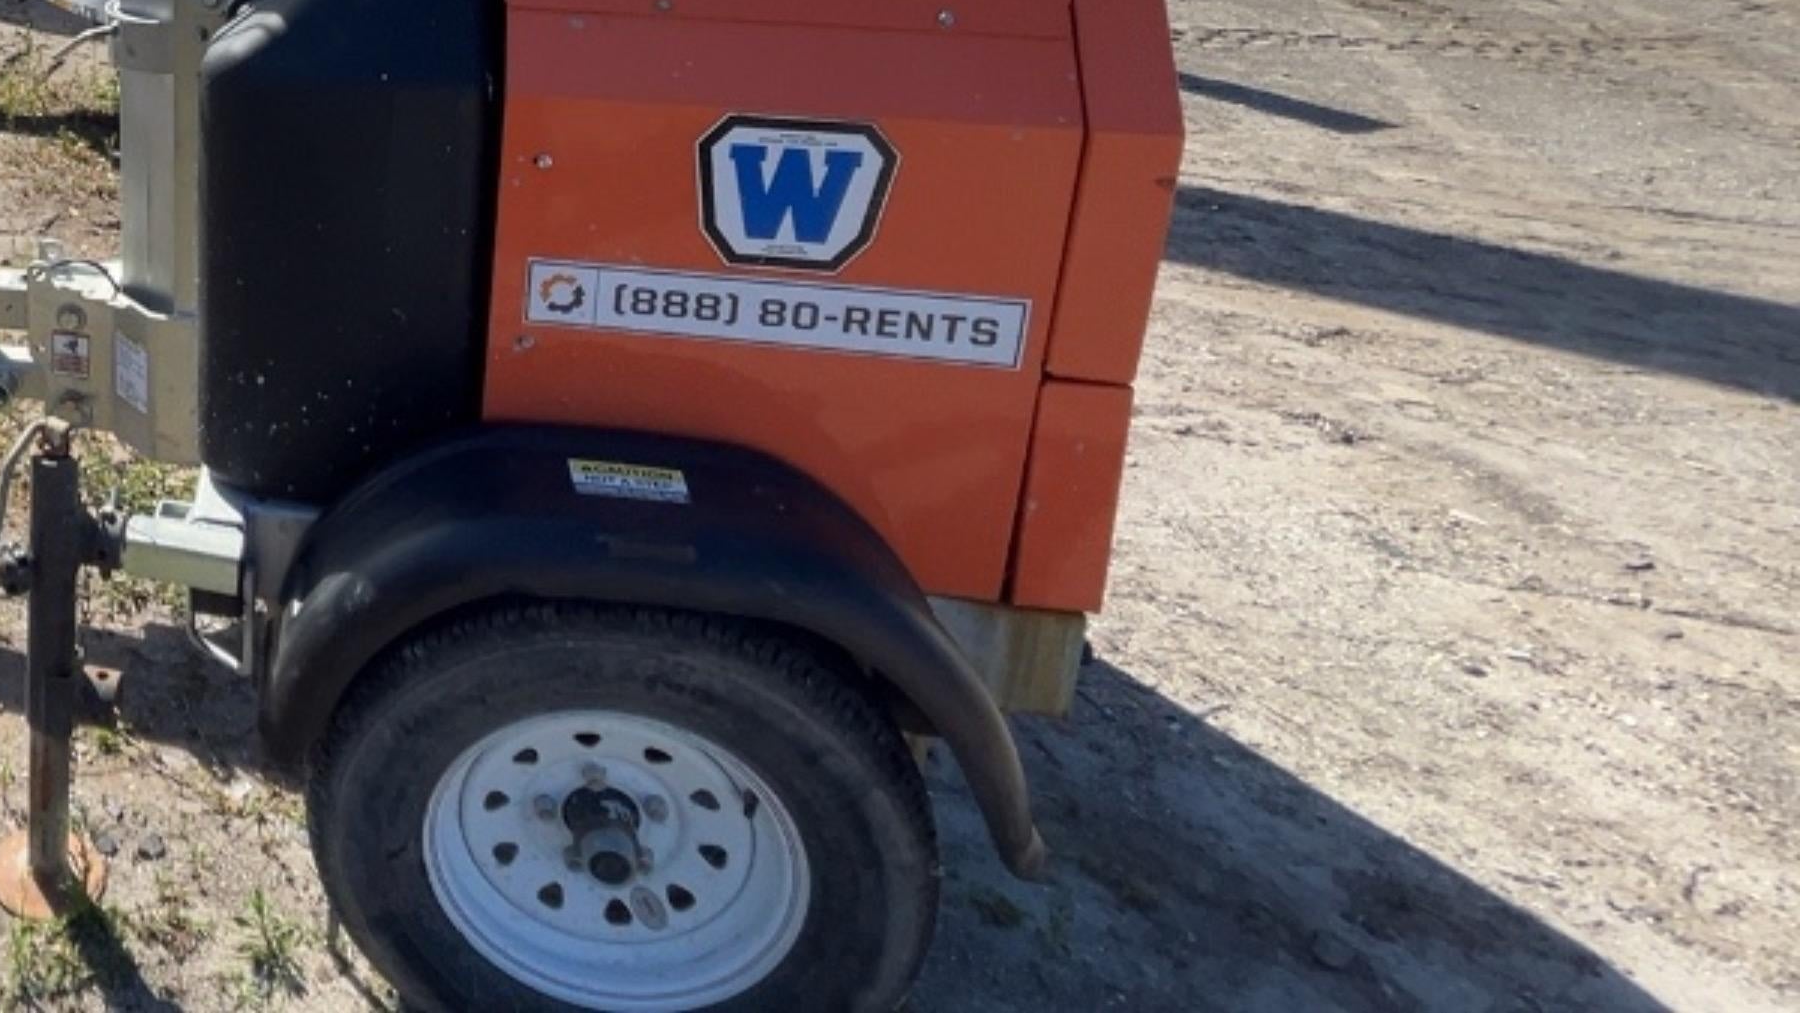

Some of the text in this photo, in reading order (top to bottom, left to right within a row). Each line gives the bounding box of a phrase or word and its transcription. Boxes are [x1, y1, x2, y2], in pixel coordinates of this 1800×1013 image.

[729, 143, 864, 245] W
[612, 283, 1001, 348] (888) 80-RENTS
